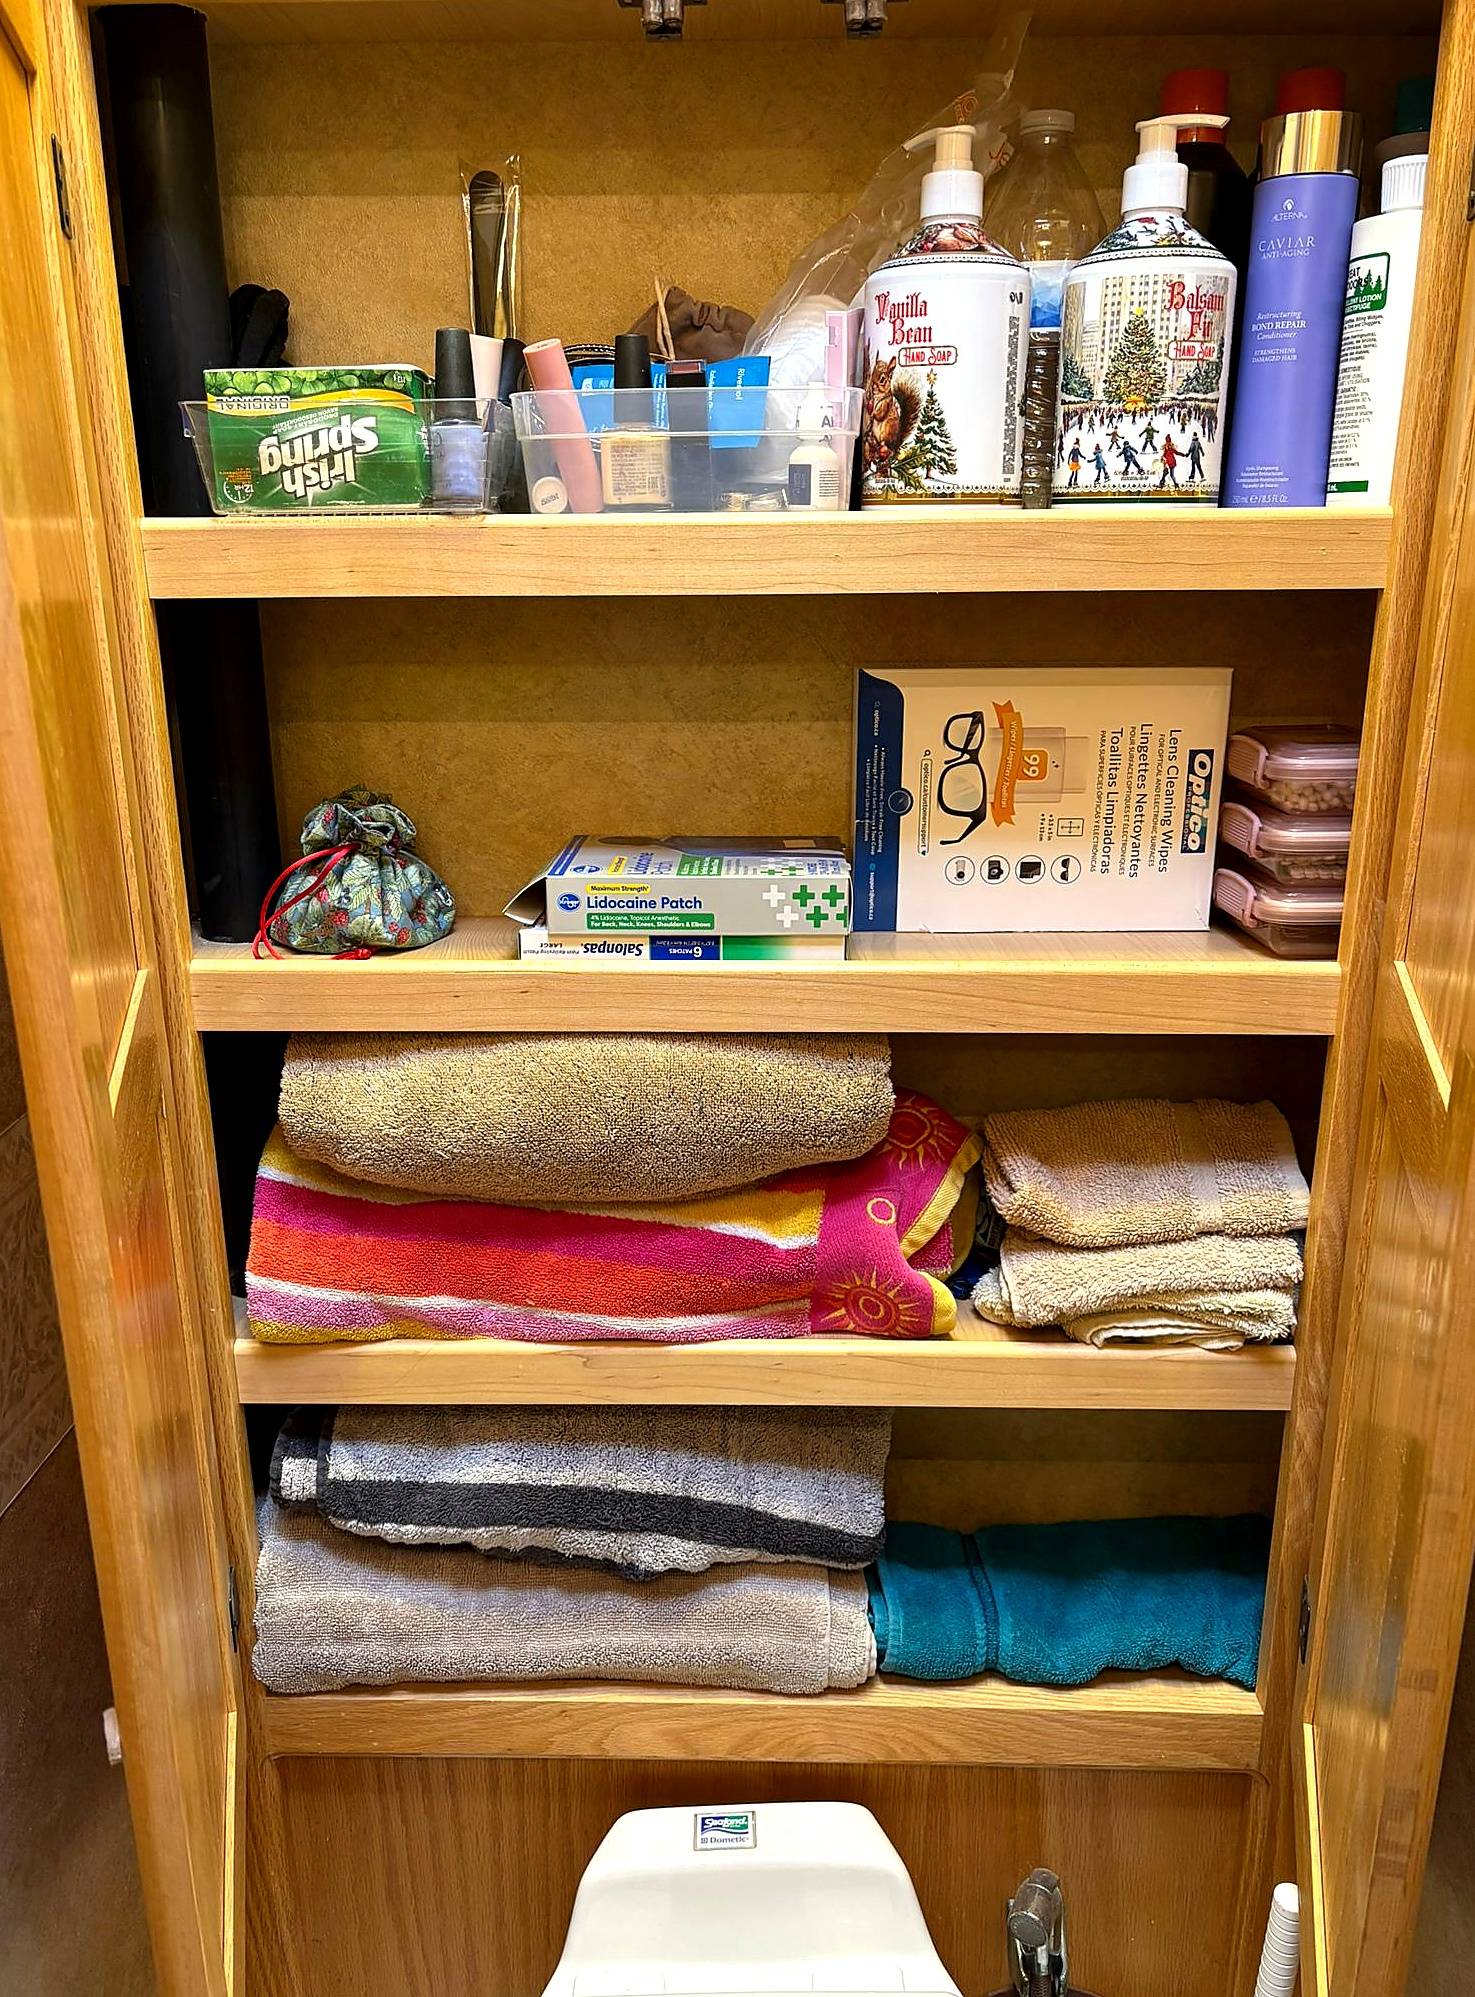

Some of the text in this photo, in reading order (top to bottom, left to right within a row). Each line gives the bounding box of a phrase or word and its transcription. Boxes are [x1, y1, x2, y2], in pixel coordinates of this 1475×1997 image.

[1258, 236, 1315, 251] CAVIAR
[1262, 248, 1310, 260] ANTI-AGING
[875, 292, 928, 324] Vanilla
[1164, 281, 1224, 311] Balsam
[1359, 293, 1382, 302] LOTION
[1187, 309, 1213, 340] Fir
[1252, 320, 1306, 331] BOND REPAIR
[1257, 312, 1302, 320] Restructuring
[888, 318, 932, 345] Bean
[1257, 332, 1296, 340] Conditioner
[1254, 348, 1296, 356] STRENGTHENS
[273, 412, 338, 434] DEODORANT SOAP
[259, 415, 378, 474] Spring
[283, 451, 355, 498] Irish
[1010, 721, 1018, 742] Wipes
[1004, 747, 1016, 776] Lingettes
[1023, 754, 1039, 776] 99
[1096, 749, 1105, 790] SUPERFICIES
[1127, 747, 1135, 779] SURFACES
[1156, 749, 1164, 776] OPTICAL
[920, 763, 930, 847] optico.ca/customersupport
[1100, 728, 1123, 874] Toallitas Limpiadoras
[1123, 781, 1132, 814] OPTIQUES
[1129, 724, 1153, 878] Lingettes Nettoyantes
[1158, 730, 1182, 872] Lens Cleaning Wipes
[1188, 753, 1211, 850] Optico
[1151, 794, 1160, 833] ELECTRONIC
[1182, 786, 1192, 850] PROFESSIONAL
[1149, 836, 1157, 867] SURFACES
[587, 896, 702, 909] Lidocaine Patch
[584, 941, 644, 956] Salonpas
[694, 946, 702, 957] 6
